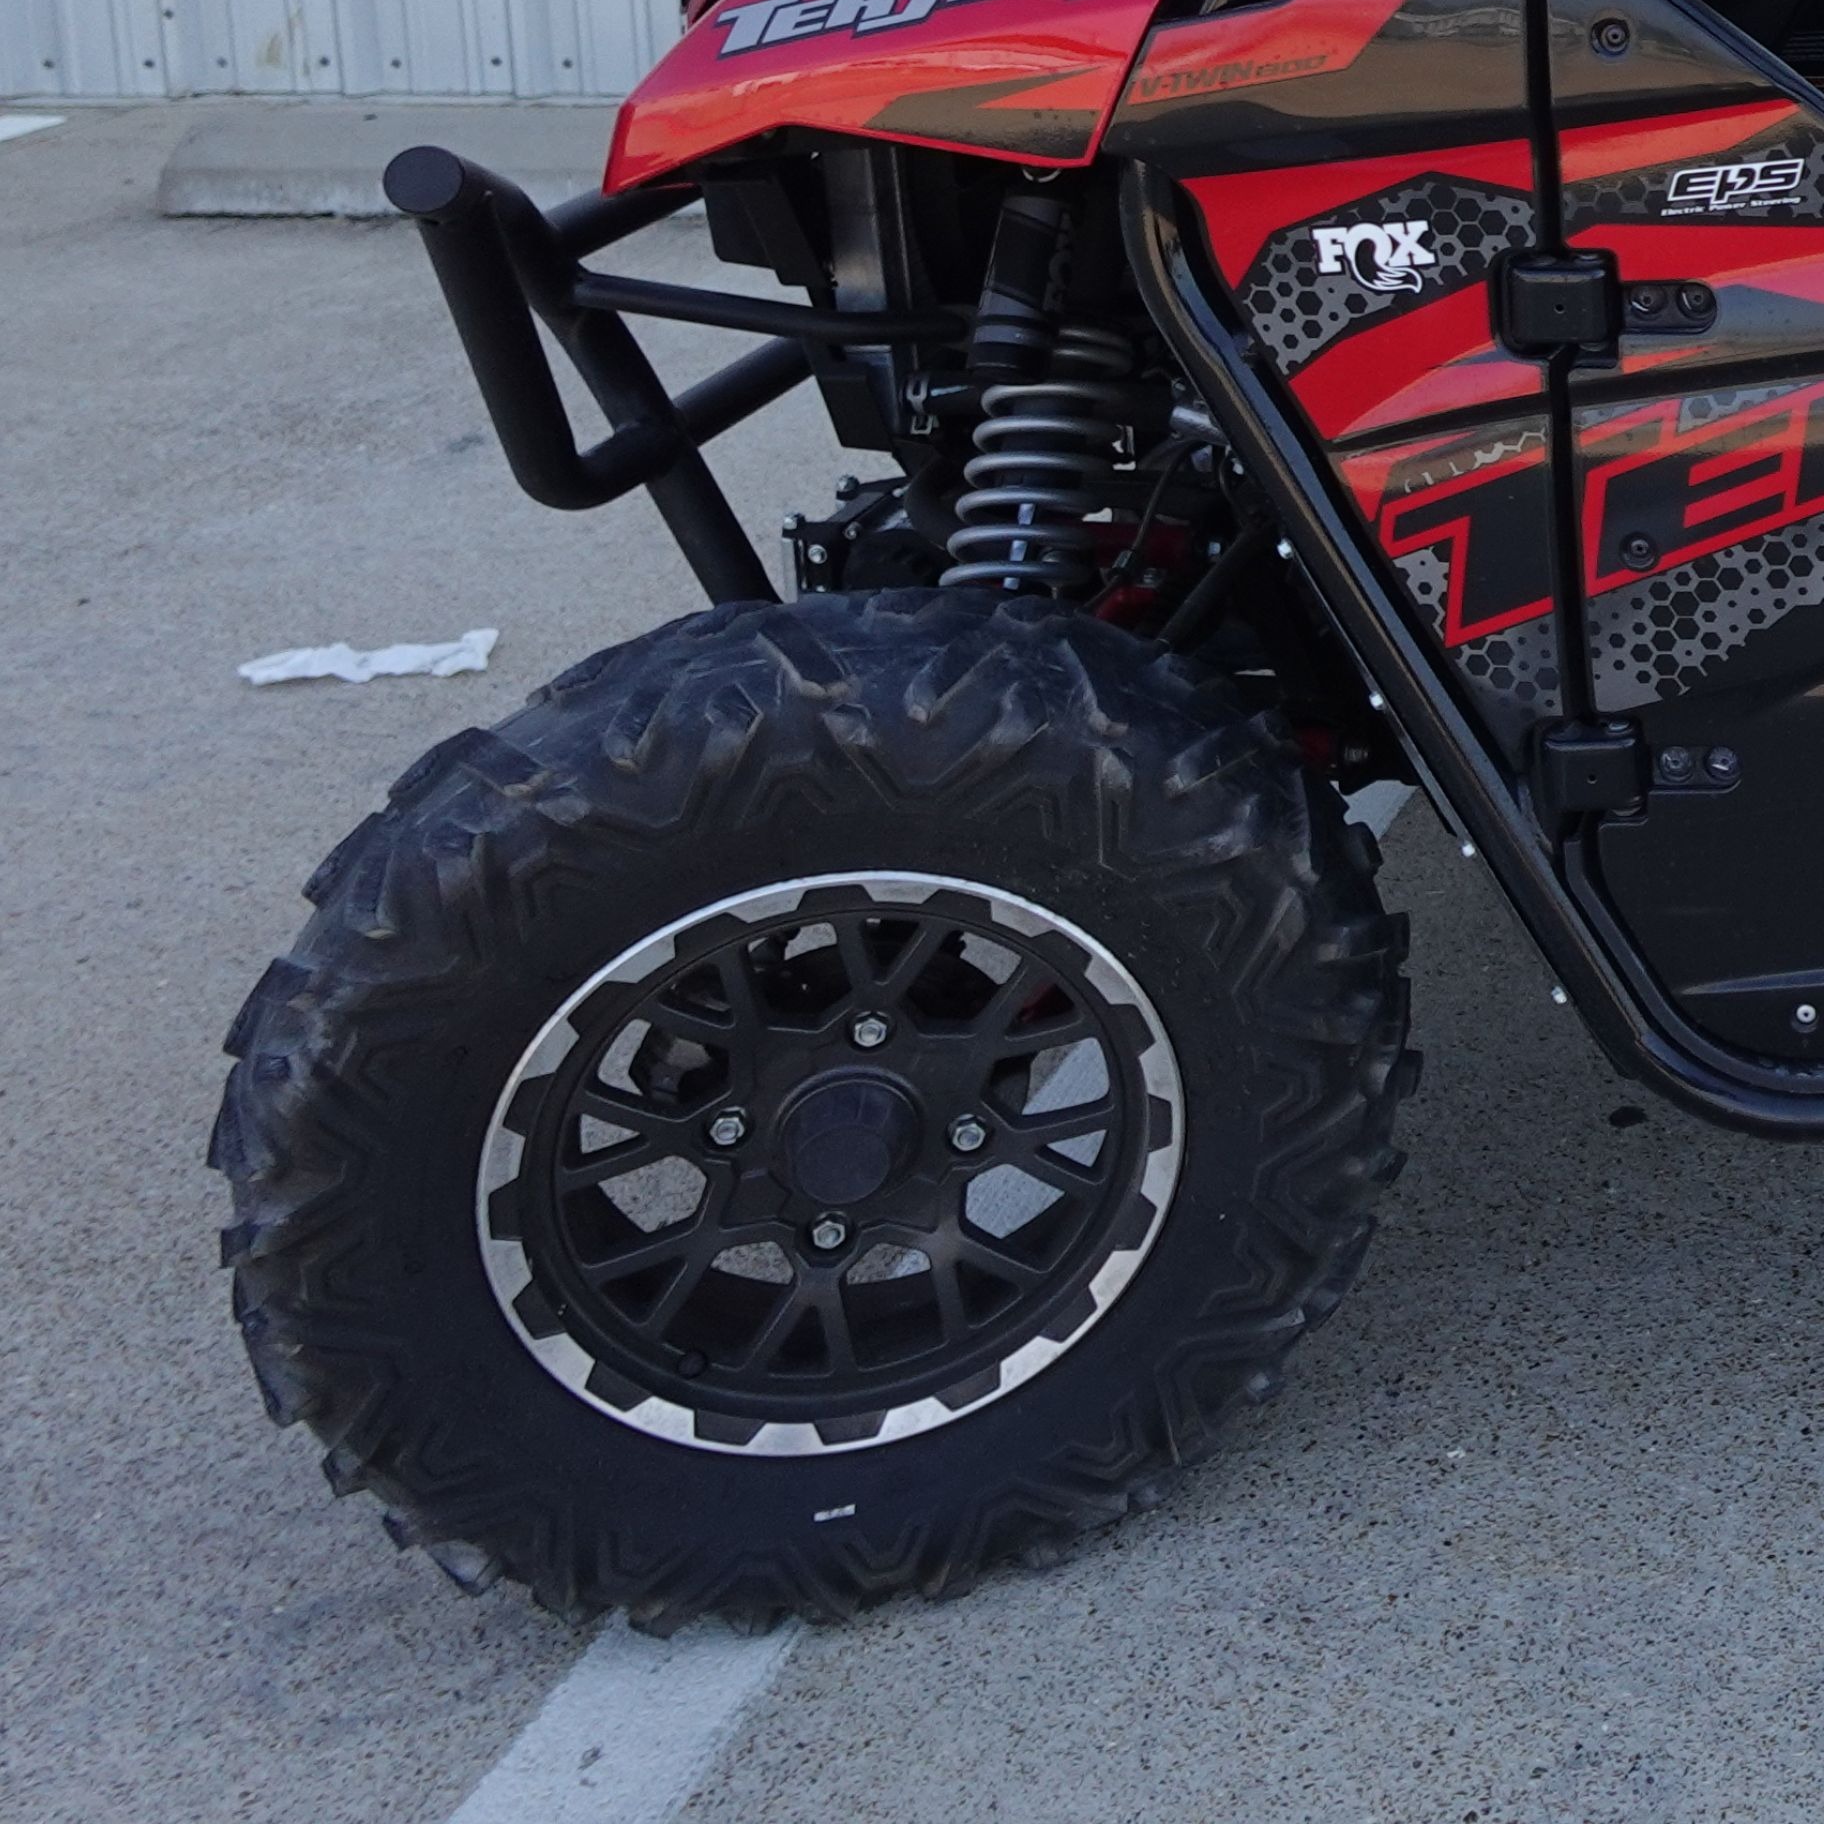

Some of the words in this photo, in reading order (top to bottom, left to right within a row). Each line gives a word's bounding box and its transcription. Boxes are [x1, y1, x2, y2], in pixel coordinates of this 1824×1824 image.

[1140, 61, 1254, 98] V-TWIN
[1667, 159, 1804, 204] EPS
[1661, 205, 1705, 217] Electric
[1709, 201, 1747, 211] Power
[1750, 197, 1802, 208] Steering
[1312, 220, 1436, 293] FOX
